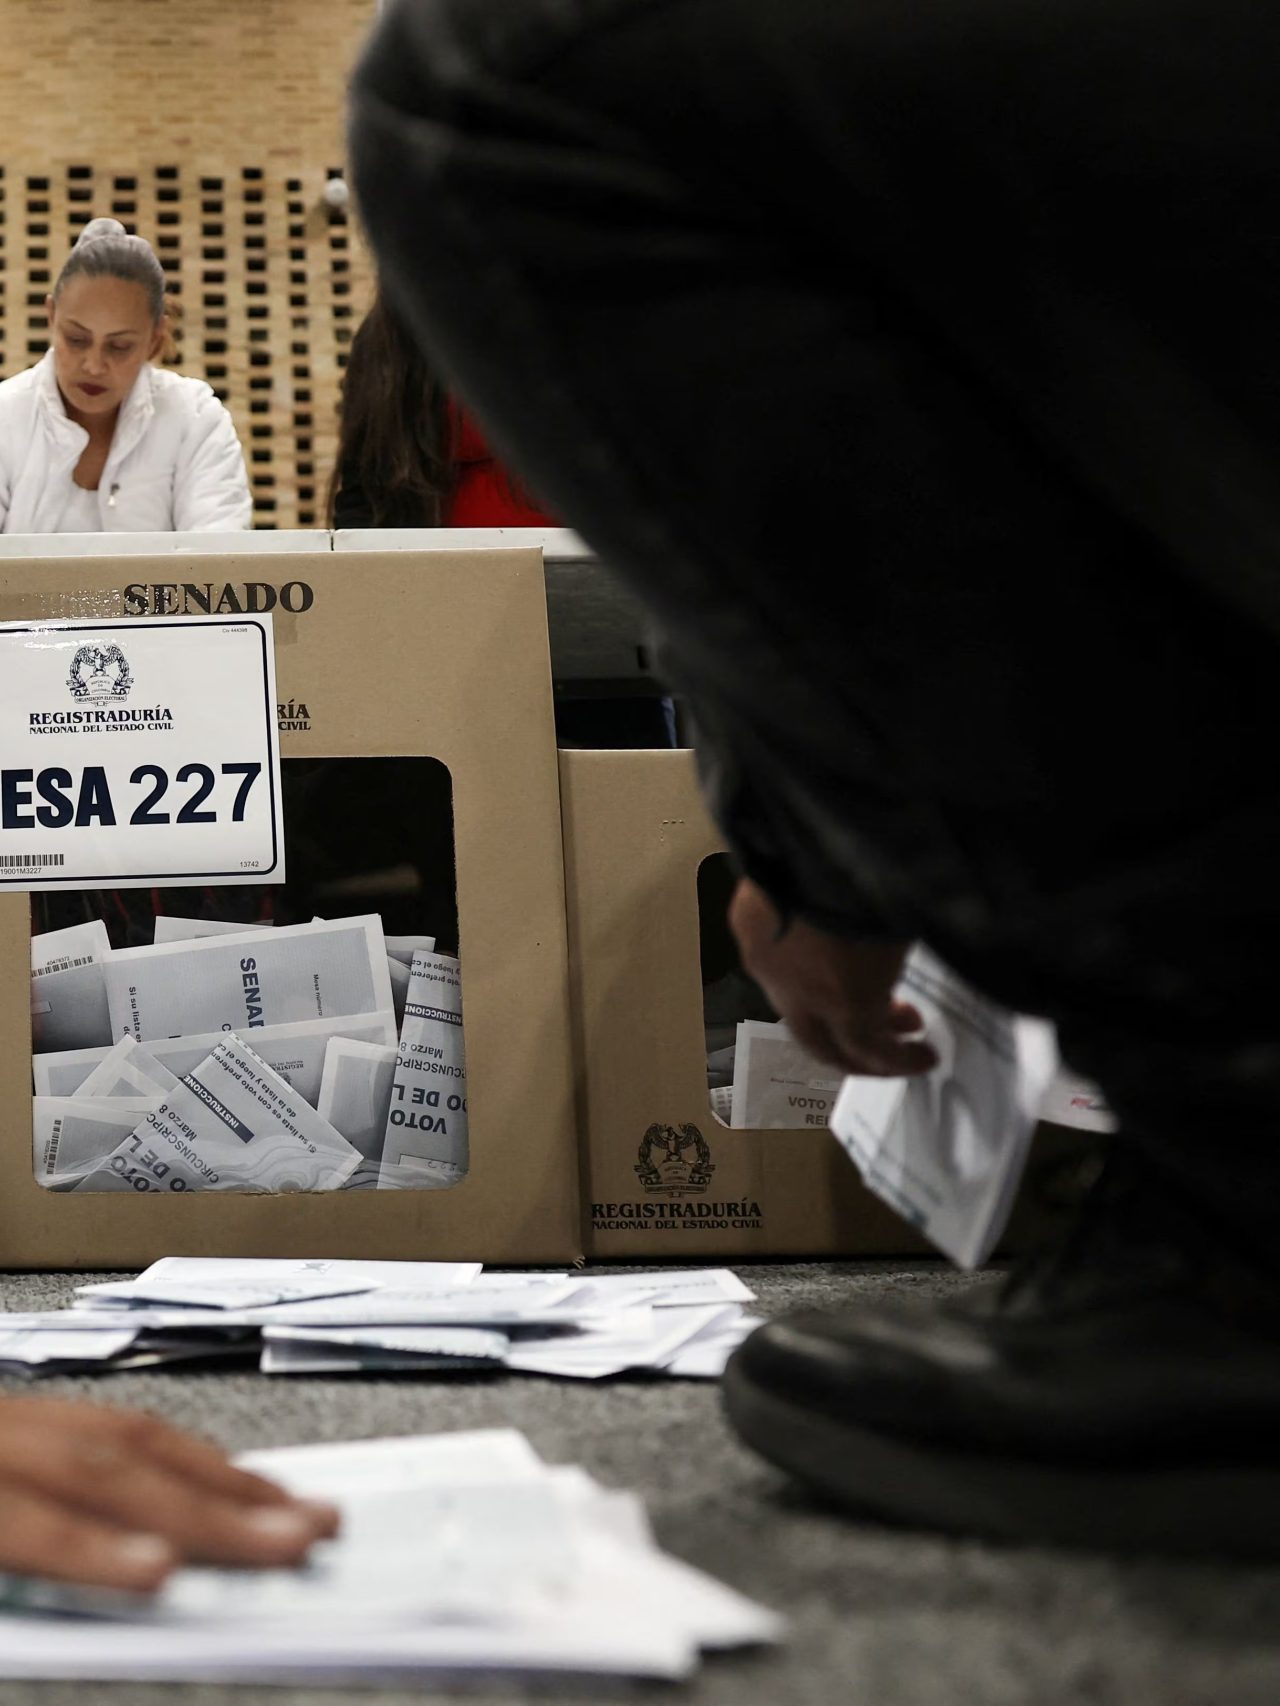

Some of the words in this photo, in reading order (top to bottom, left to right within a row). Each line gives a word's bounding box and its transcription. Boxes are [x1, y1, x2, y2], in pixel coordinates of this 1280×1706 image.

[123, 581, 314, 615] SENADO
[30, 704, 173, 725] REGISTRADURÍA
[30, 726, 79, 734] NACIONAL
[106, 724, 144, 732] ESTADO
[278, 722, 311, 730] CIVIL
[128, 762, 262, 826] 227
[412, 971, 446, 982] preferen
[129, 986, 136, 995] Si
[131, 998, 136, 1009] su
[226, 1050, 235, 1059] el
[400, 1042, 407, 1052] 8
[411, 1044, 443, 1059] Marzo
[211, 1051, 243, 1080] preferen
[235, 1057, 256, 1080] luego
[241, 1080, 257, 1097] voto
[255, 1077, 263, 1086] y
[261, 1083, 278, 1101] lista
[412, 1087, 440, 1107] DE
[159, 1104, 168, 1114] 8
[183, 1075, 240, 1129] INSTRUCCIONE
[258, 1095, 272, 1110] con
[278, 1099, 286, 1109] la
[788, 1096, 827, 1110] VOTO
[272, 1110, 282, 1119] es
[286, 1107, 296, 1118] de
[168, 1112, 197, 1142] Marzo
[281, 1118, 299, 1136] lista
[390, 1109, 447, 1134] VOTO
[298, 1134, 308, 1145] su
[146, 1113, 219, 1184] CIRCUNSCRIPC
[140, 1149, 171, 1179] DE
[111, 1156, 160, 1192] OTO
[170, 1178, 196, 1192] O
[592, 1197, 762, 1218] REGISTRADURÍA
[592, 1220, 650, 1230] NACIONAL
[655, 1220, 678, 1229] DEL
[683, 1220, 728, 1229] ESTADO
[732, 1219, 763, 1228] CIVIL
